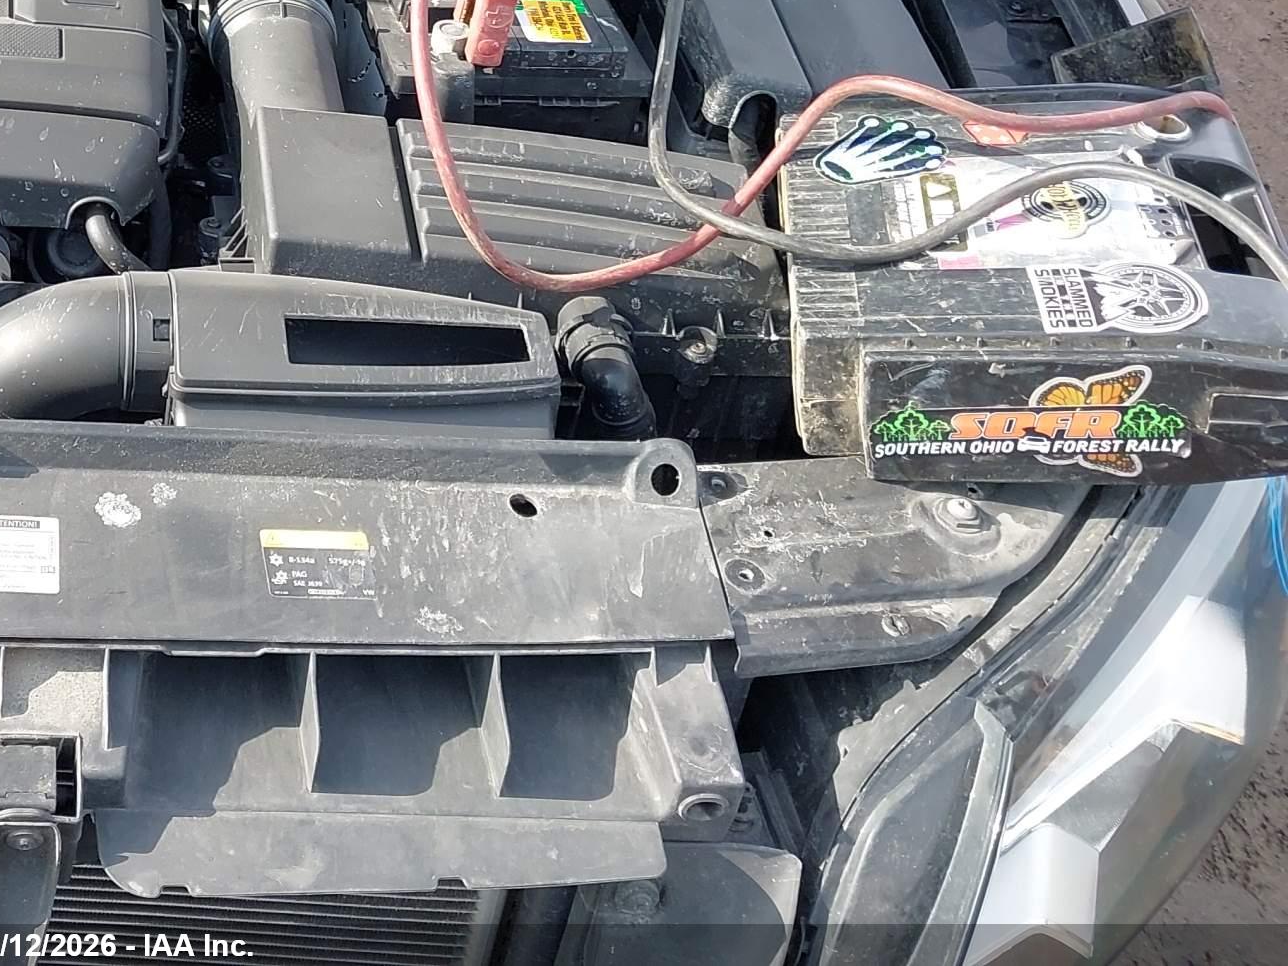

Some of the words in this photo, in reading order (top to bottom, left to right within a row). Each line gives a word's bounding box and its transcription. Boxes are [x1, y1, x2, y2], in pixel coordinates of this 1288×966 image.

[1062, 267, 1094, 329] SLAMMED
[949, 410, 1122, 441] SOFR
[874, 439, 966, 459] SOUTHERN
[969, 440, 1015, 454] OHIO
[1052, 439, 1124, 454] FOREST
[1124, 438, 1186, 454] RALLY
